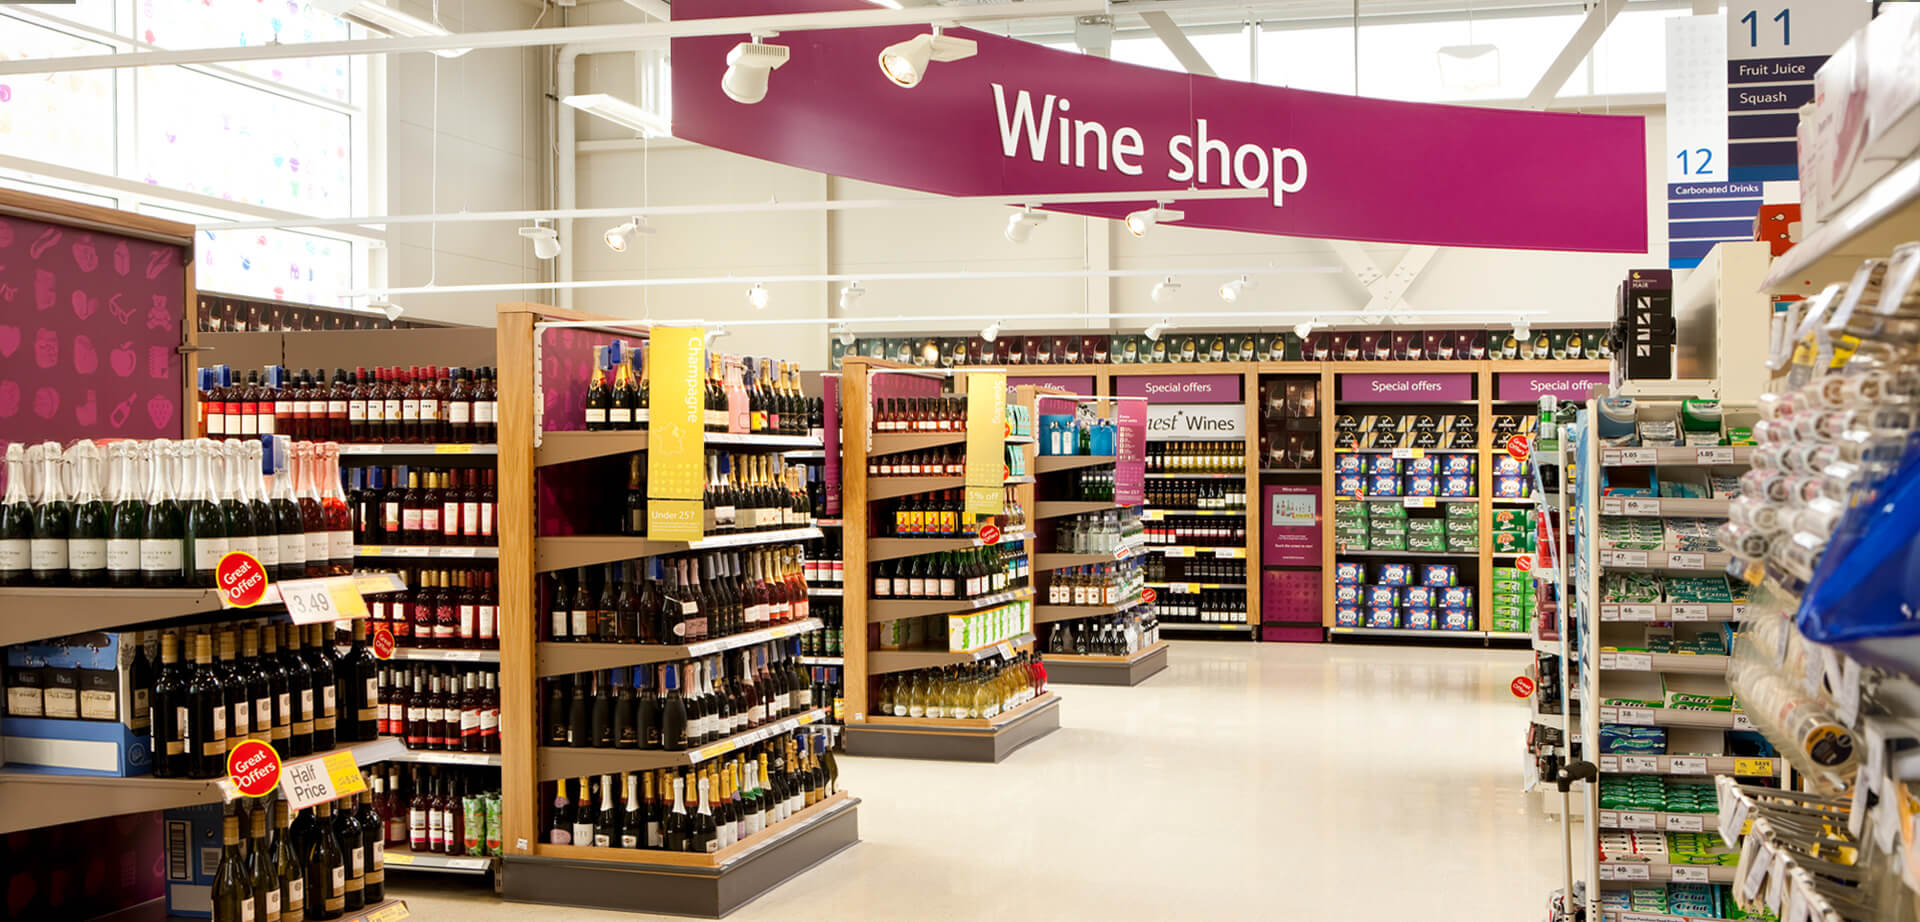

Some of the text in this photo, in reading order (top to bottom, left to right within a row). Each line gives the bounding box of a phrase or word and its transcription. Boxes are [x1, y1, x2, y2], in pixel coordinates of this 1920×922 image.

[1740, 7, 1791, 48] 11
[1739, 63, 1806, 76] Fruit Juice
[1739, 91, 1788, 105] Squash
[990, 82, 1308, 207] Wine shop
[1676, 147, 1713, 175] 12
[1675, 183, 1759, 196] Carbonated Drinks
[685, 337, 702, 424] Champagne
[1145, 382, 1212, 394] Special offers
[1371, 380, 1442, 393] Special offers
[1530, 379, 1569, 392] Special
[1185, 415, 1235, 431] Wines
[223, 560, 253, 585] Great
[230, 571, 263, 599] Offers
[235, 750, 267, 774] Great
[241, 761, 276, 788] Offers
[289, 764, 315, 786] Half
[294, 782, 328, 803] Price
